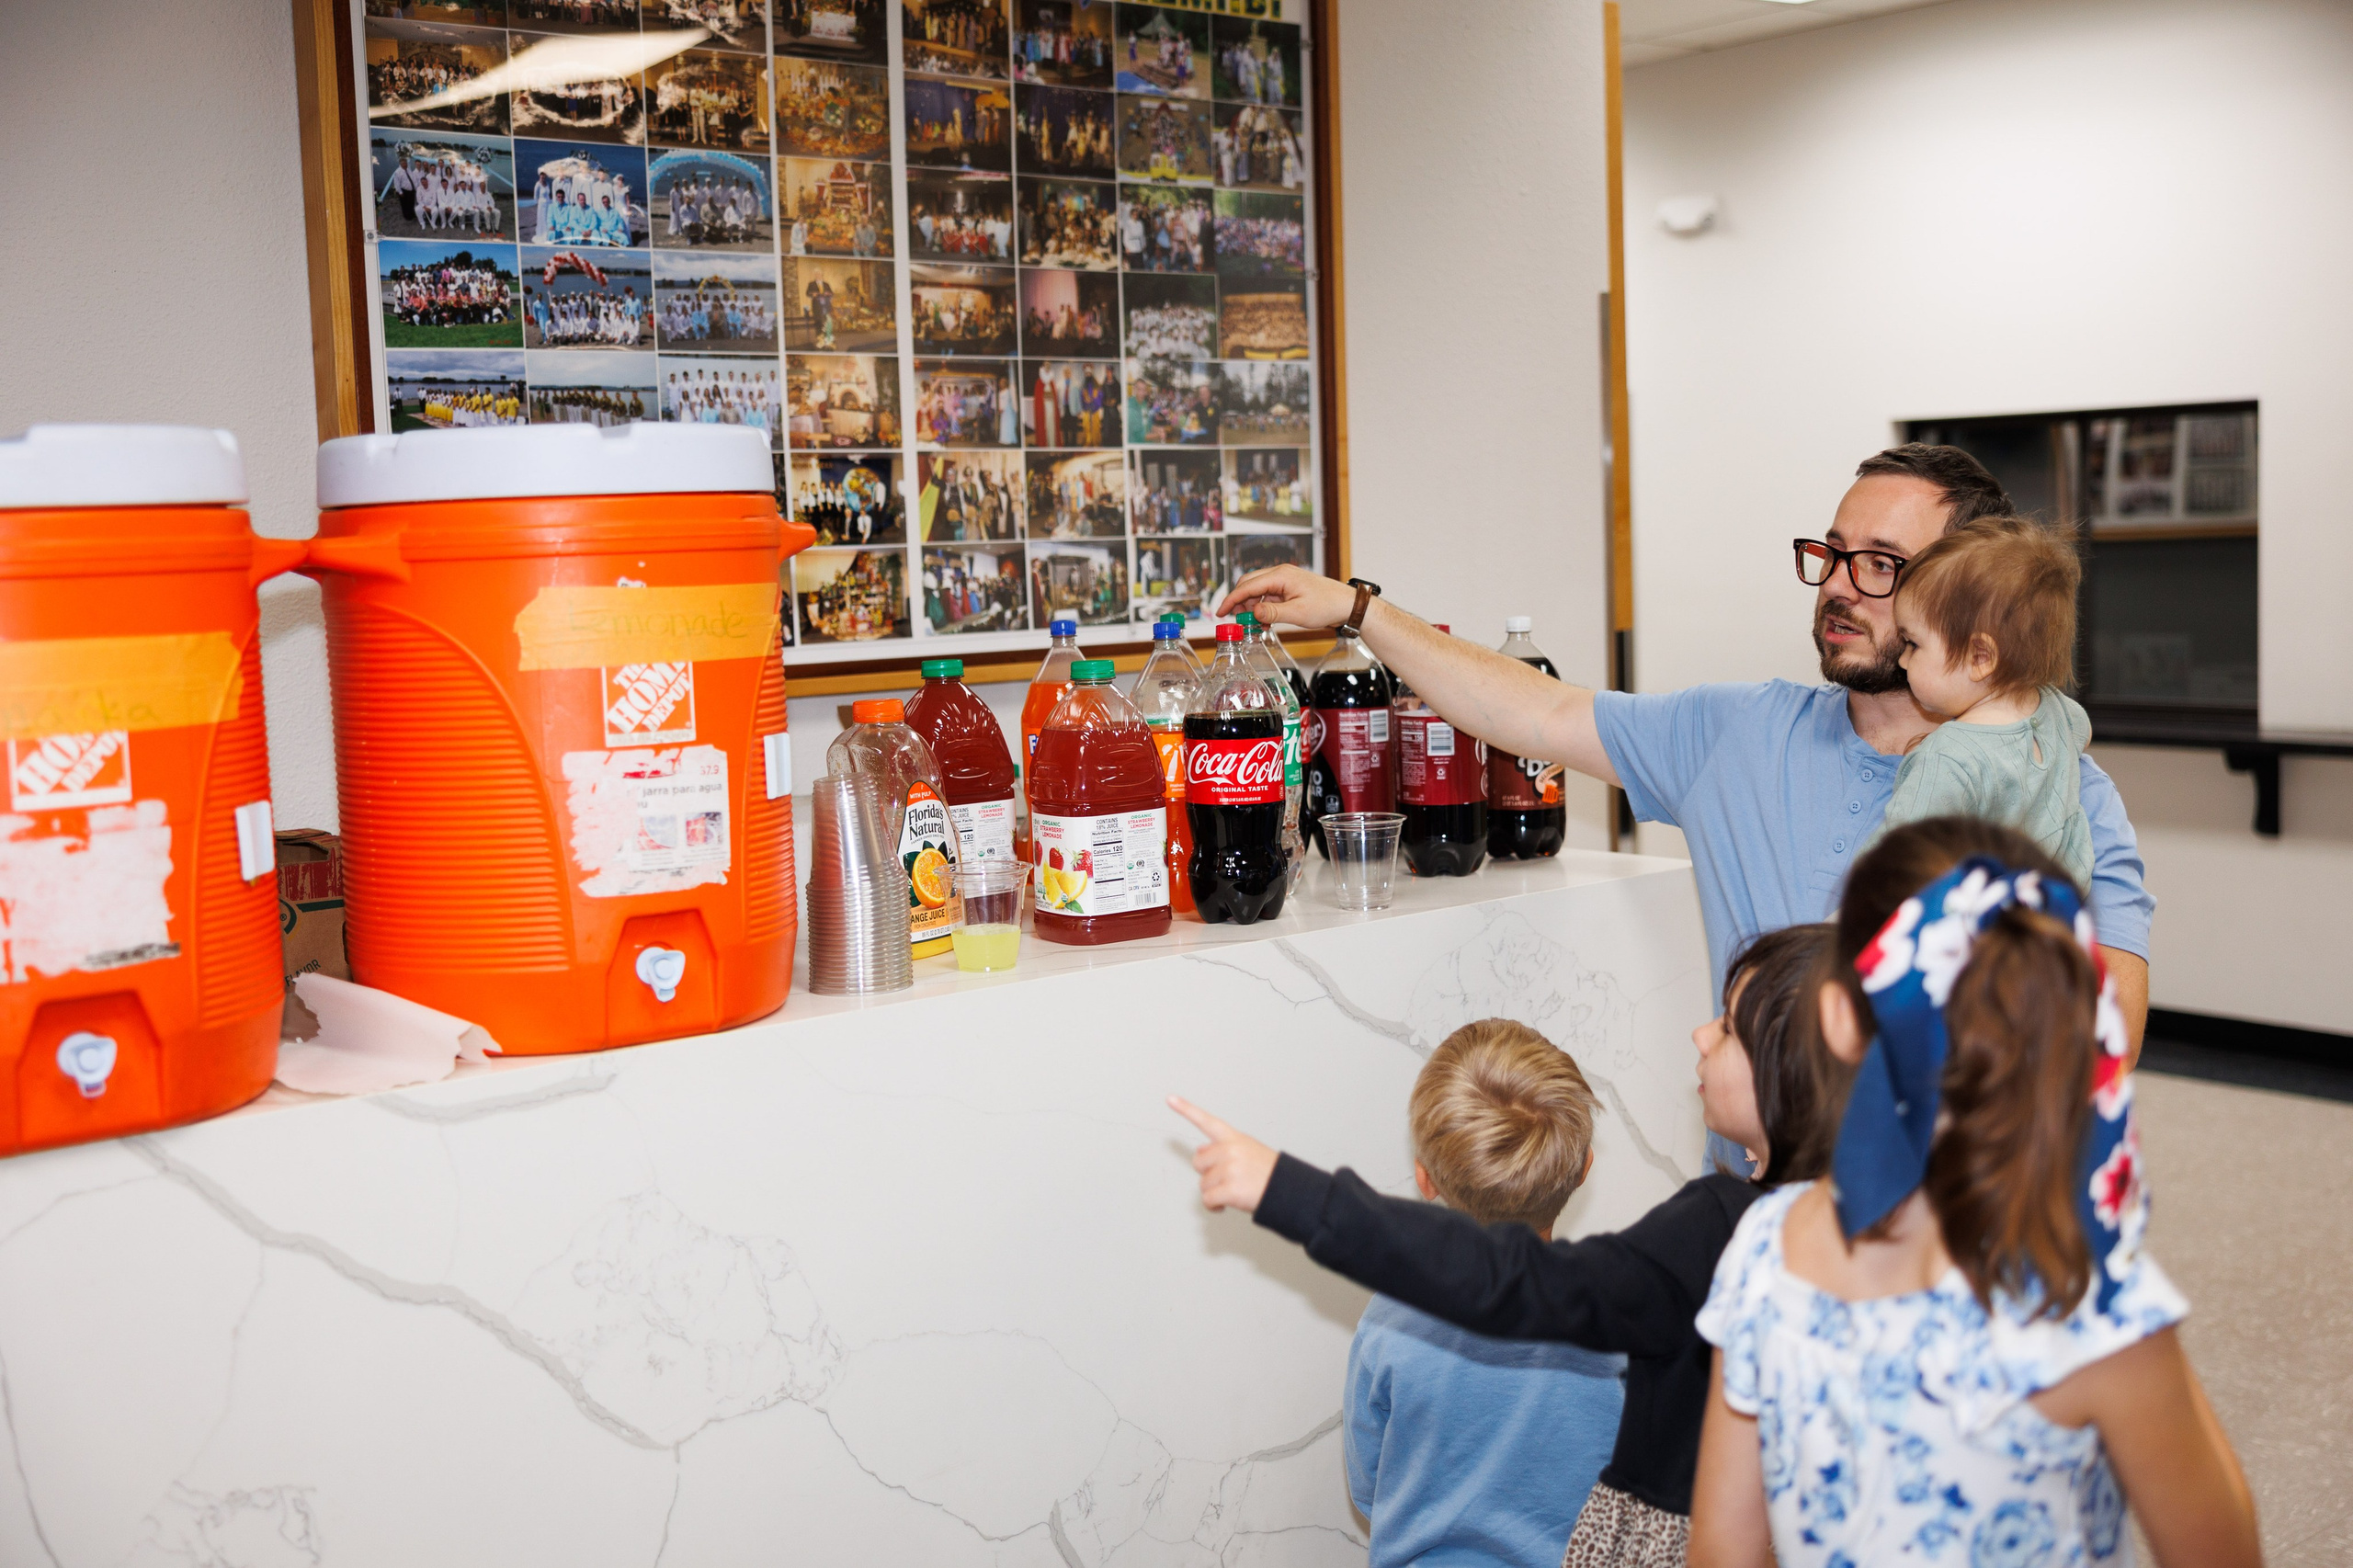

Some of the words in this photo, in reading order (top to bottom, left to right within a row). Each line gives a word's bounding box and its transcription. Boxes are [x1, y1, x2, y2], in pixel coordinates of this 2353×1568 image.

[567, 599, 747, 639] Lemonade
[641, 672, 691, 733] DEPOT
[1187, 741, 1283, 785] Coca-Cola
[642, 786, 668, 797] jarra
[672, 785, 696, 797] para
[699, 783, 722, 794] agua
[908, 804, 943, 825] Florida's
[1096, 817, 1119, 825] CONTAINS
[909, 821, 945, 841] Natural
[1040, 825, 1065, 834] STRAWBERRY
[911, 912, 928, 924] ANGE
[929, 908, 946, 920] JUICE
